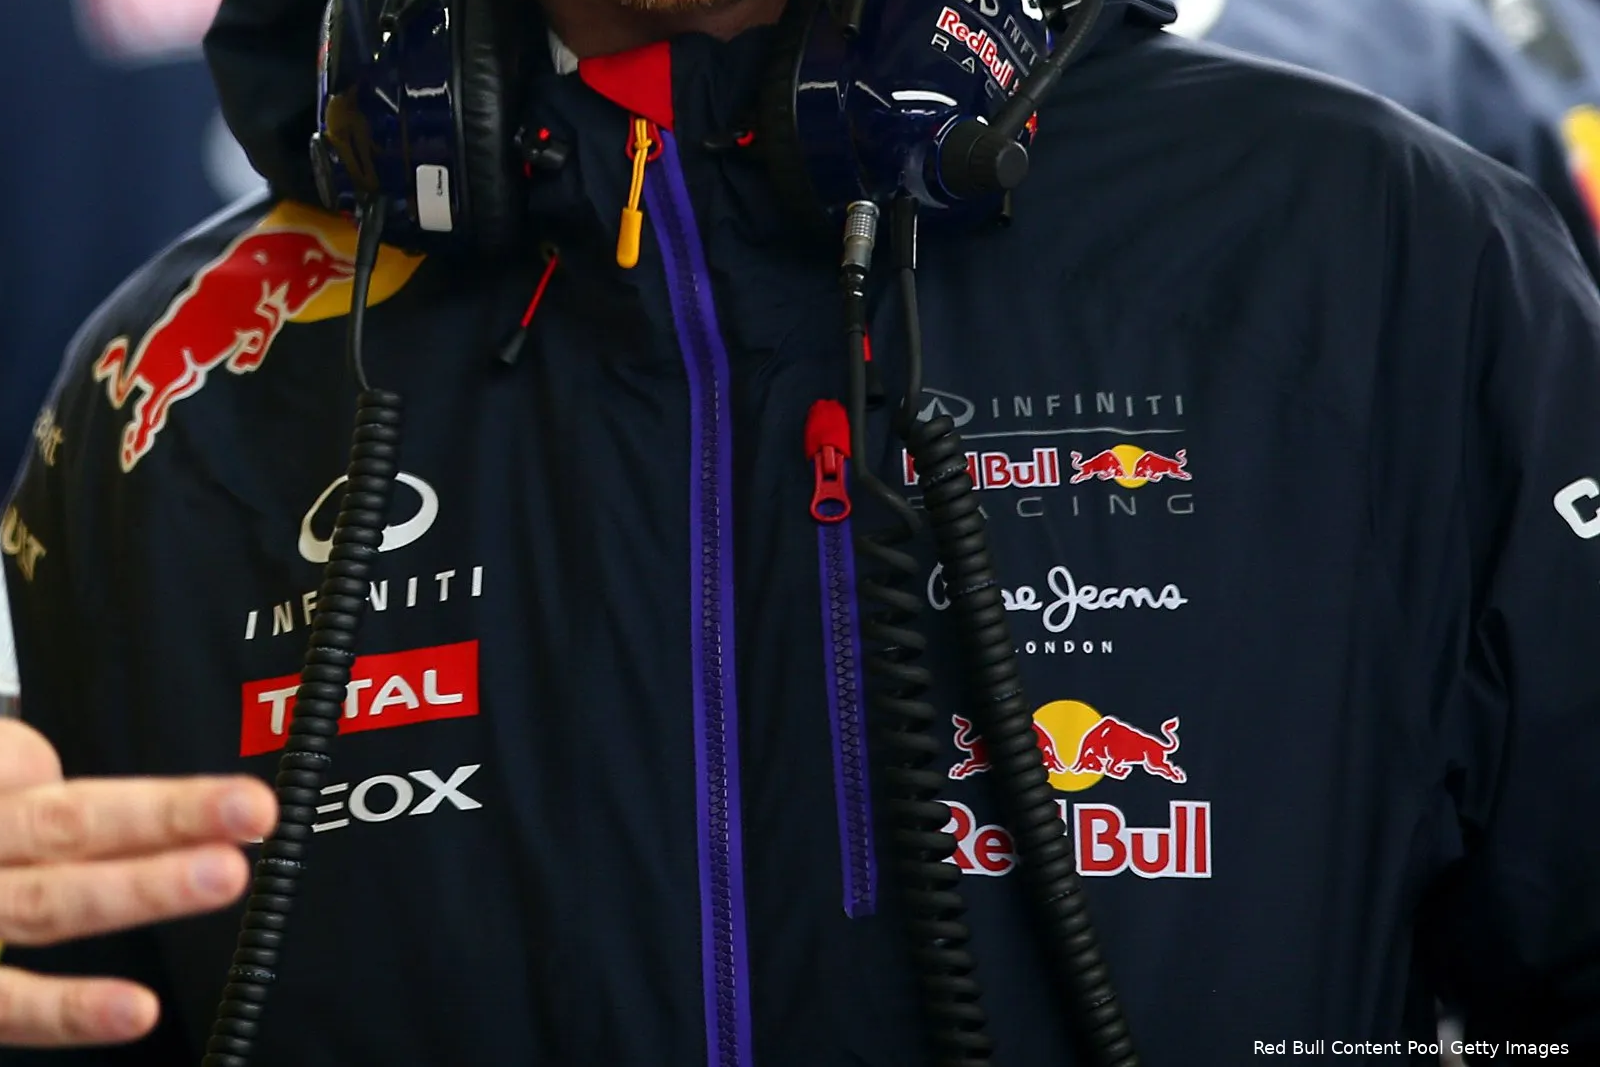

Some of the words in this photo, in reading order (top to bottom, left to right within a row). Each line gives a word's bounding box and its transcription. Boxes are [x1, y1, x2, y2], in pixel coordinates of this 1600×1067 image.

[992, 391, 1184, 418] INFINITI
[980, 447, 1061, 490] Bull
[244, 565, 484, 640] INFNITI
[1042, 565, 1189, 633] Jeans
[1014, 640, 1113, 655] ONDON
[257, 669, 464, 735] TTAL
[248, 763, 484, 844] EOX
[1073, 800, 1212, 879] Bull
